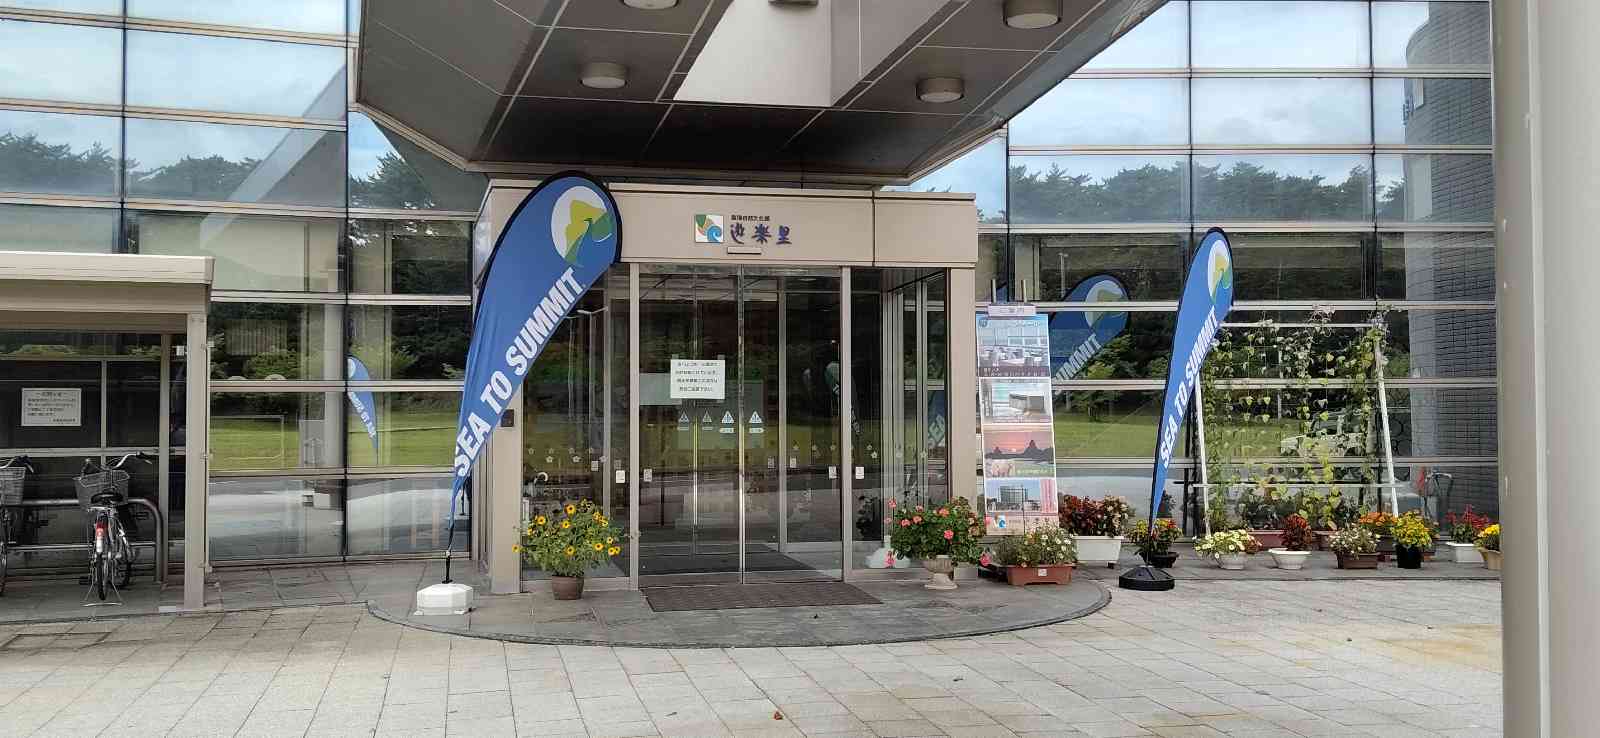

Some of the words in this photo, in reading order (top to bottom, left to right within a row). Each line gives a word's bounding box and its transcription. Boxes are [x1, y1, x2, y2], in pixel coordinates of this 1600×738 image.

[454, 412, 491, 477] SEA
[480, 370, 513, 415] TO
[505, 267, 584, 376] SUMMIT
[1160, 415, 1177, 468] SEA
[1175, 381, 1189, 417] TO
[1186, 305, 1219, 386] SUMMIT
